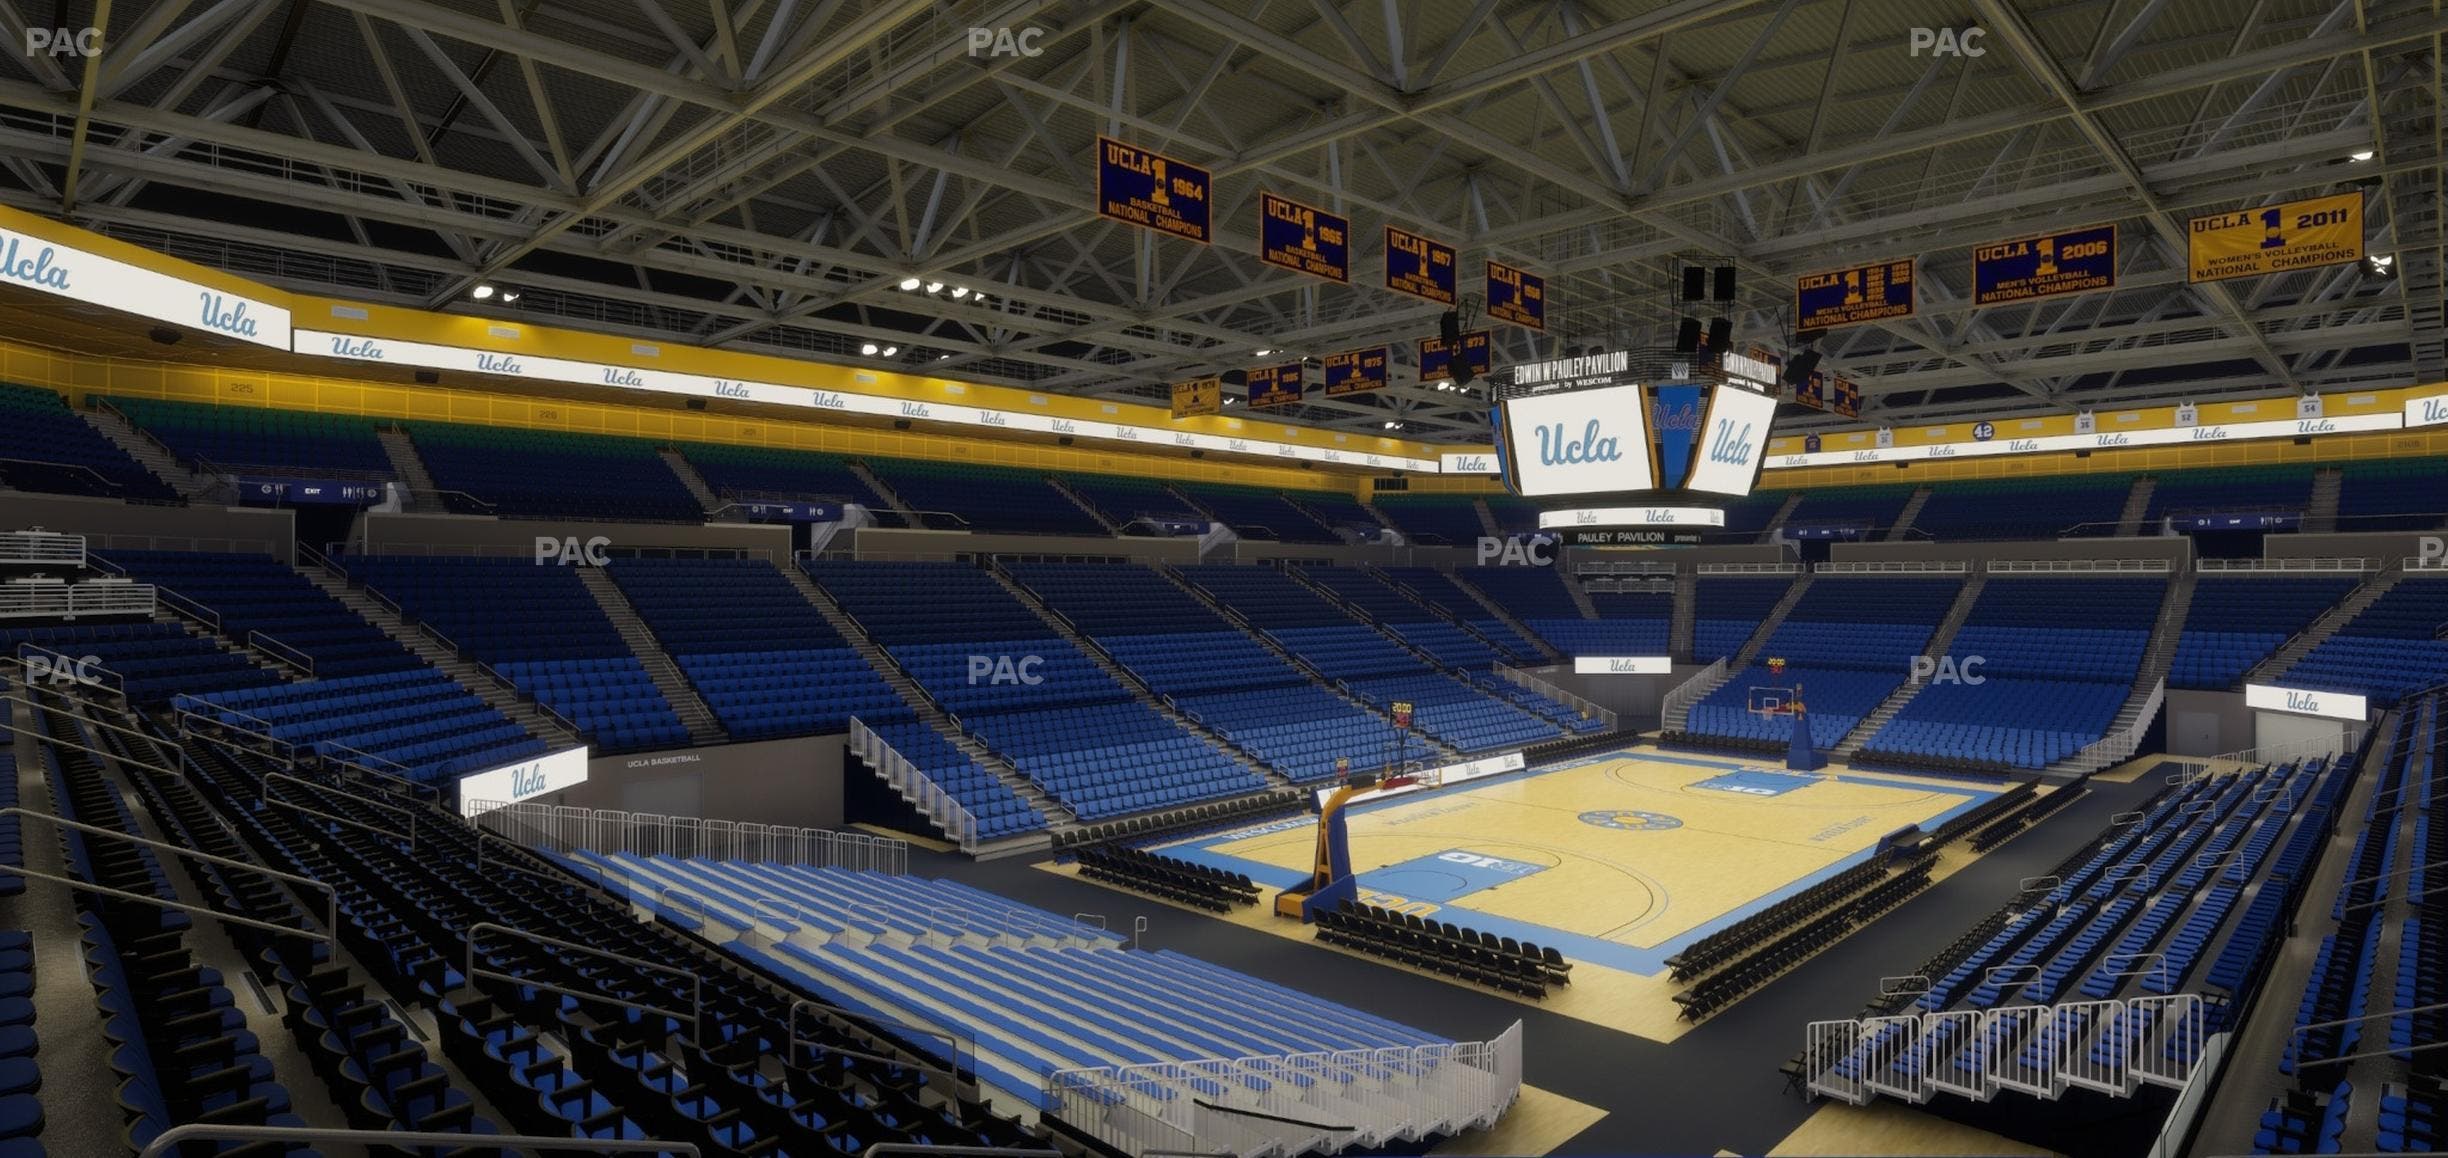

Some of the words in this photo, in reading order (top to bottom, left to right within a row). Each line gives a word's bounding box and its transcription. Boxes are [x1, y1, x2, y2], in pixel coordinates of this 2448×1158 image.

[1107, 143, 1151, 177] UCLA
[1151, 159, 1170, 207] 1
[1172, 177, 1203, 202] 1964
[1130, 197, 1182, 219] BASKETBALL
[1108, 201, 1150, 224] NATIONAL
[1155, 214, 1202, 238] CHAMPIONS
[1268, 198, 1303, 225] UCLA
[1302, 210, 1317, 251] 1
[2193, 212, 2251, 233] UCLA
[2260, 208, 2287, 250] 1
[2296, 208, 2348, 229] 2011
[1268, 248, 1302, 267] NATIONAL
[1305, 259, 1343, 279] CHAMPIONS
[1390, 231, 1419, 255] UCLA
[1418, 240, 1429, 277] 1
[1978, 242, 2030, 262] UCLA
[2036, 239, 2058, 276] 1
[2062, 240, 2108, 260] 2006
[2196, 262, 2260, 279] NATIONAL
[2271, 248, 2355, 269] CHAMPIONS
[2208, 252, 2262, 266] WOMEN'S
[2265, 242, 2339, 257] VOLLEYBALL
[1490, 264, 1513, 285] UCLA
[1513, 271, 1523, 306] 1
[1800, 273, 1839, 289] UCLA
[1845, 271, 1863, 304] 1
[1981, 288, 2036, 303] NATIONAL
[2038, 275, 2108, 295] CHAMPIONS
[1996, 278, 2027, 290] MEN'S
[2028, 269, 2091, 285] VOLLEYBALL
[200, 292, 258, 338] Ucla
[1803, 313, 1848, 327] NATIONAL
[1850, 305, 1908, 321] CHAMPIONS
[332, 337, 385, 361] Ucla
[477, 352, 523, 374] Ucla
[1514, 362, 1542, 385] EDWIN
[1542, 362, 1551, 381] W
[1552, 357, 1585, 380] PAULEY
[1585, 351, 1628, 376] PAVILION
[603, 367, 644, 387] Ucla
[1564, 380, 1573, 389] by
[1576, 376, 1612, 387] WESCOM
[231, 383, 254, 394] 225
[714, 380, 751, 398] Ucla
[812, 391, 846, 408] Ucla
[901, 402, 930, 417] Ucla
[980, 411, 1005, 425] Ucla
[2423, 399, 2448, 422] Uc
[1974, 425, 1993, 438] 42
[2192, 428, 2227, 440] Ucla
[2297, 420, 2336, 433] Ucla
[1535, 419, 1623, 467] Ucla
[1711, 418, 1752, 466] Ucla
[2008, 440, 2038, 453] Ucla
[2096, 433, 2130, 446] Ucla
[1929, 445, 1956, 458] Ucla
[1456, 455, 1488, 471] Ucla
[1645, 508, 1676, 523] Ucla
[1577, 532, 1613, 543] PAULEY
[1617, 531, 1665, 543] PAVILION
[1609, 659, 1636, 672] Ucla
[2286, 691, 2320, 712] Ucla
[628, 759, 649, 769] UCLA
[651, 753, 701, 766] BASKETBALL
[512, 764, 546, 799] Ucla
